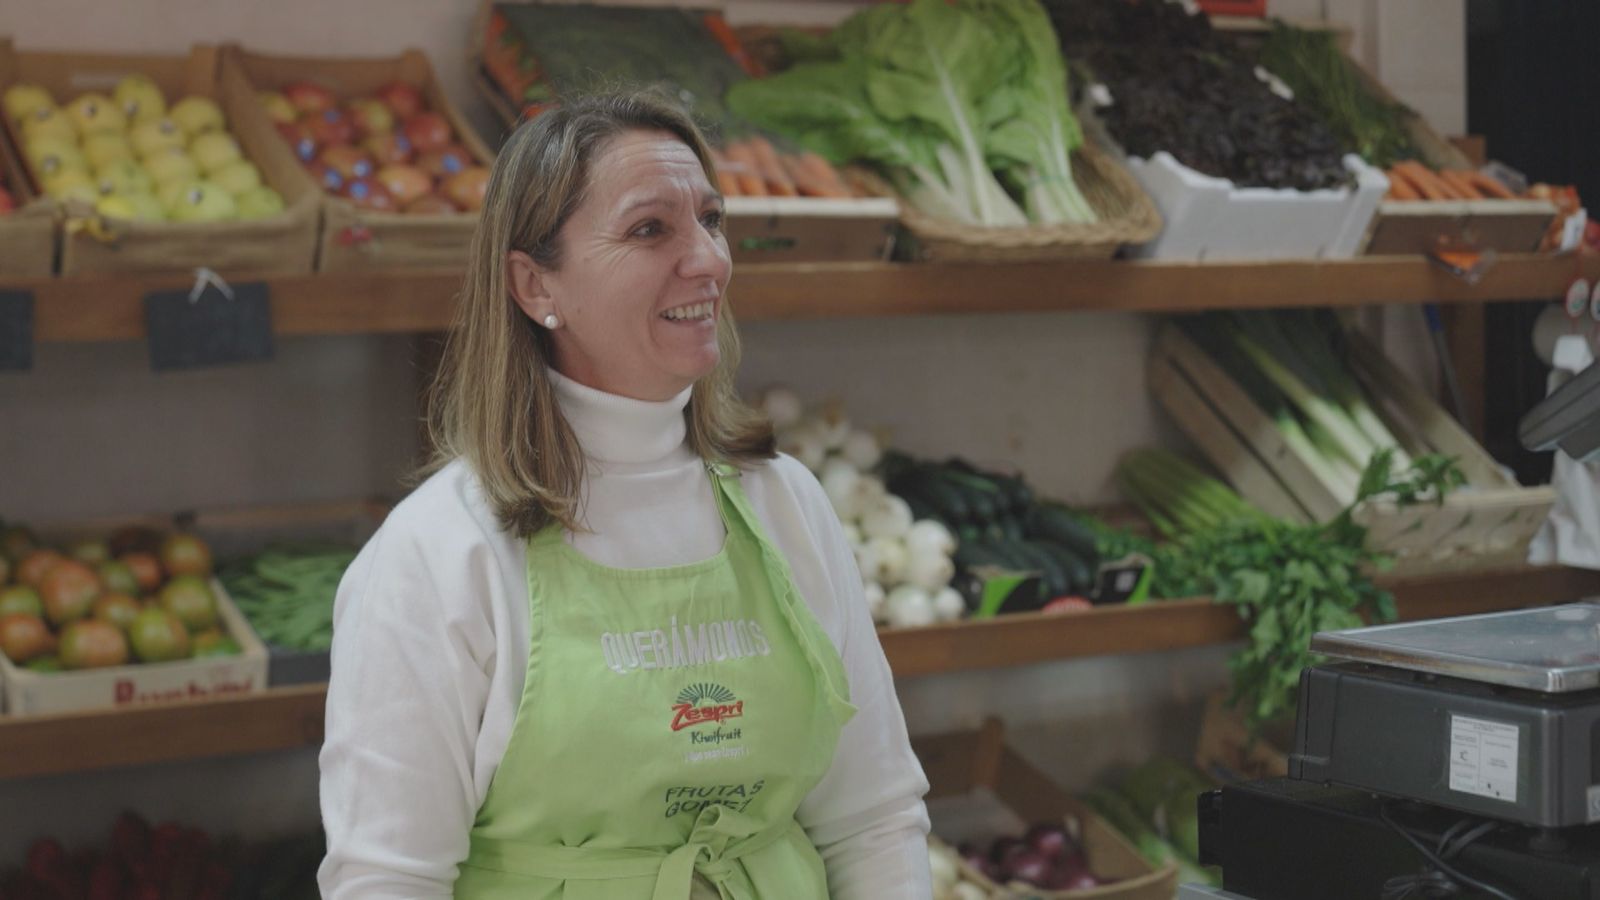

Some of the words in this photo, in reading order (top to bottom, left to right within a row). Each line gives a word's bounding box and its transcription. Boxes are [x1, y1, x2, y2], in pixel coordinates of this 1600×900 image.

[601, 614, 771, 674] QUERÁMONOS
[670, 700, 743, 731] Zespri
[691, 727, 742, 744] Kiwifruit
[665, 780, 765, 802] FRUTAS
